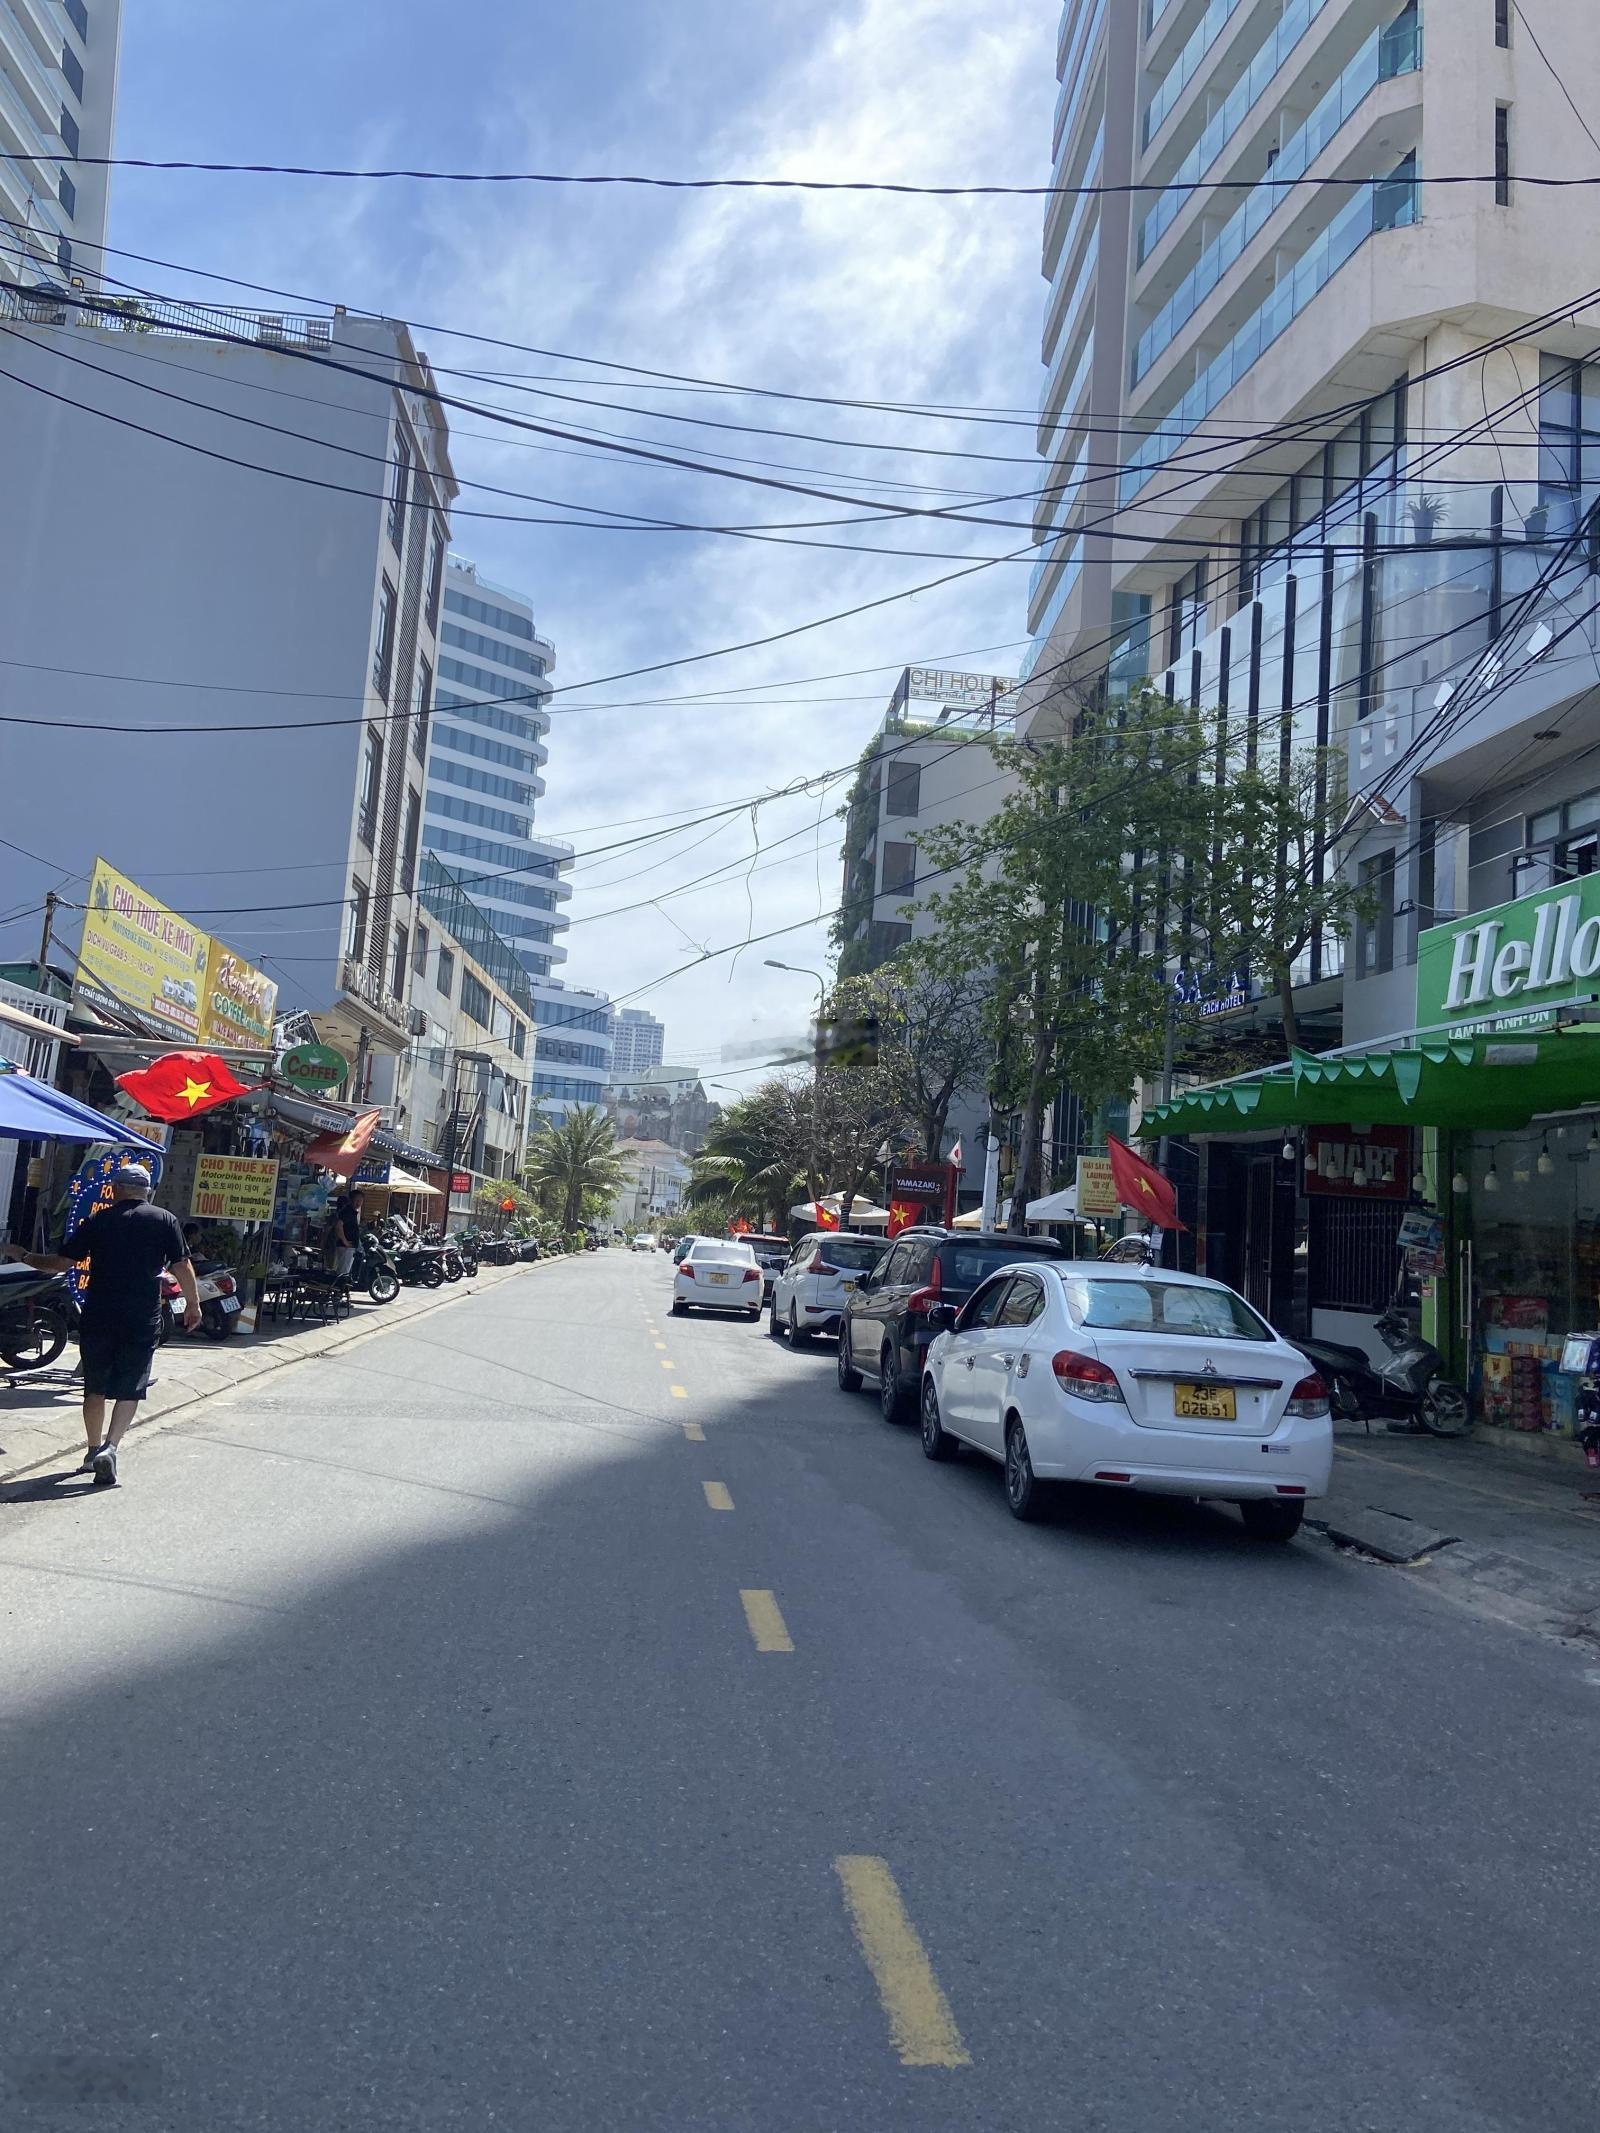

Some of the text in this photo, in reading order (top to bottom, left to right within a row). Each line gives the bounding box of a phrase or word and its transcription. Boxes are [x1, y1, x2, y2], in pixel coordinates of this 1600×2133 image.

[910, 669, 943, 688] CHI
[112, 884, 134, 919] CHO
[161, 917, 174, 945] XE
[1441, 895, 1600, 1010] Hello
[288, 1055, 338, 1080] COFFEE
[200, 1158, 276, 1175] CHO THUÊ XE
[1318, 1142, 1399, 1181] MART
[201, 1170, 273, 1183] Motorbike Rental
[896, 1178, 936, 1189] YAMAZAKI
[211, 1181, 260, 1193] 오토바이 대여
[195, 1191, 225, 1215] 100K
[228, 1205, 245, 1217] 십만
[1182, 1400, 1228, 1416] 028.51
